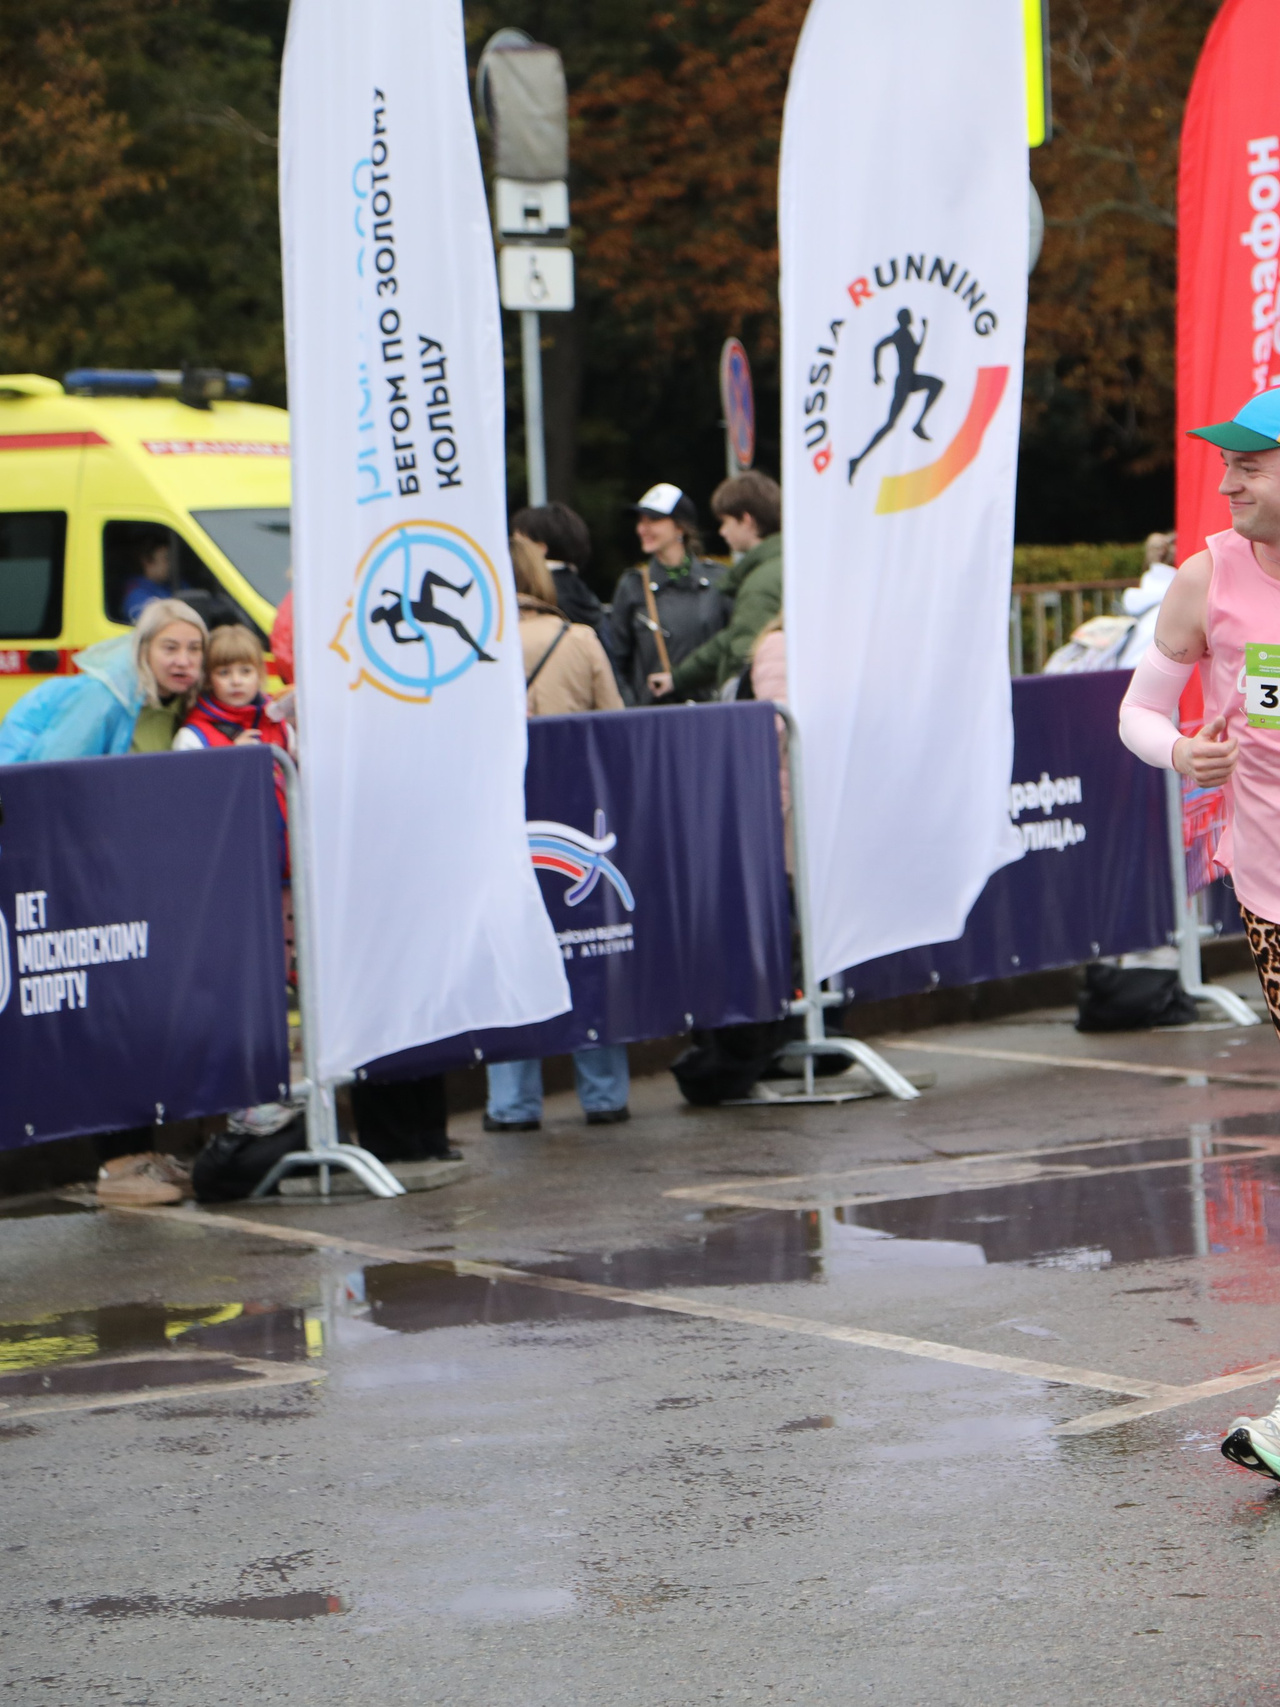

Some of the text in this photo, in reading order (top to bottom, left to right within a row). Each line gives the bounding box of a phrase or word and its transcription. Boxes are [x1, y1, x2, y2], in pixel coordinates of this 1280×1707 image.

[370, 86, 398, 297] ЗОЛОТОМУ
[846, 253, 998, 337] RUNNING
[377, 308, 403, 363] ПО
[385, 375, 422, 496] БЕГОМ
[417, 333, 462, 489] КОЛЬЦУ
[1011, 771, 1082, 819] рафон
[15, 890, 48, 931] ЛЕТ
[17, 920, 148, 974] МОСКОВСКОМУ
[20, 970, 87, 1016] СПОРТУ
